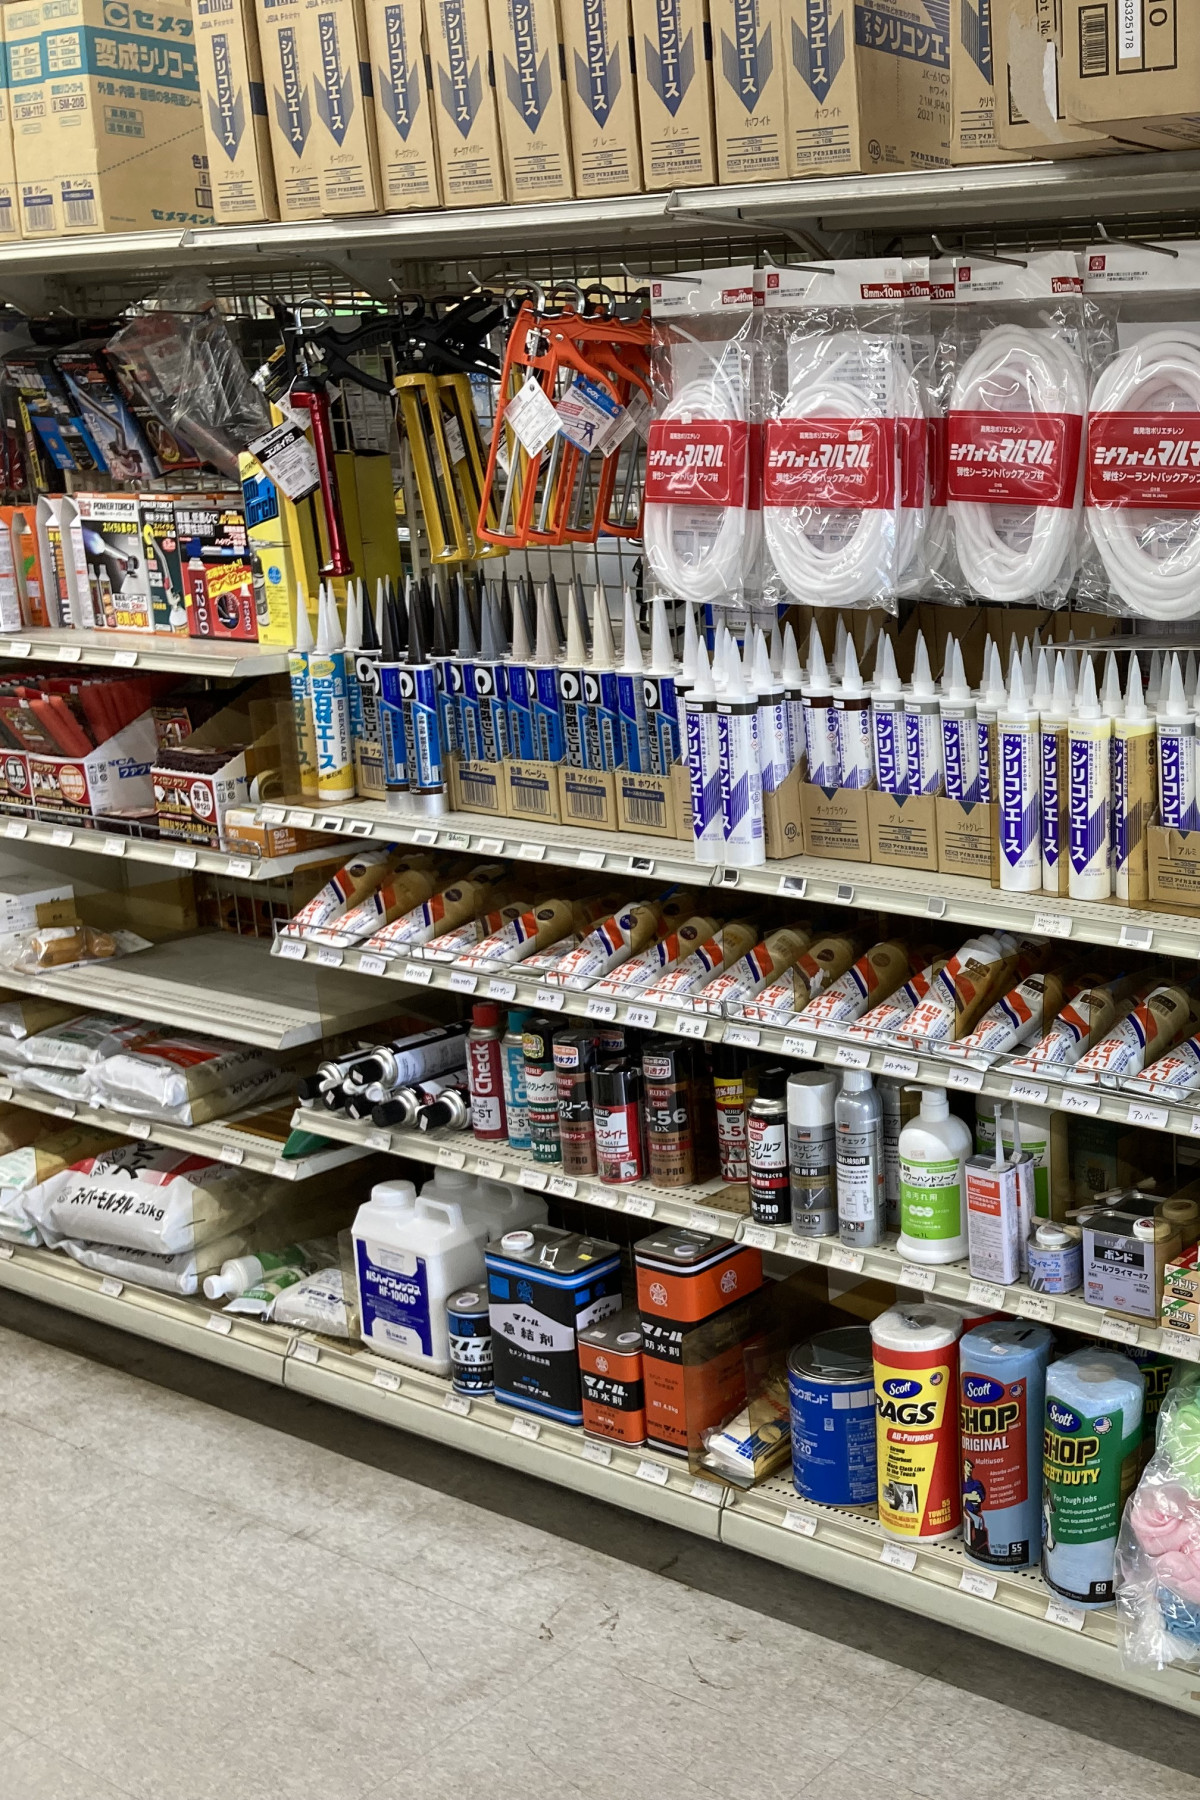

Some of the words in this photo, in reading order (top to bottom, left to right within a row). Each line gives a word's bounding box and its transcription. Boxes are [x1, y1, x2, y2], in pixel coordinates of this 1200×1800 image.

[863, 11, 873, 45] アイカ
[94, 37, 199, 80] 変成シリコー
[447, 13, 470, 122] シリコンエース
[514, 4, 539, 116] シリコンエース
[321, 25, 344, 130] シリコンエース
[387, 18, 409, 125] シリコンエース
[214, 46, 236, 146] シリコンエース
[281, 40, 303, 142] シリコンエース
[769, 444, 871, 469] ミナフォームマルマル
[949, 439, 1056, 465] ミナフォームマルマル
[194, 579, 210, 634] R200
[1071, 741, 1088, 749] アイカ
[1161, 739, 1178, 747] アイカ
[687, 725, 704, 827] シリコンエース
[1004, 745, 1021, 854] シリコンエース
[1043, 745, 1058, 853] シリコンエース
[1071, 751, 1088, 862] シリコンエース
[475, 1043, 493, 1094] Check
[794, 1167, 818, 1176] 切削剤
[902, 1172, 957, 1184] パワーハンドソープ
[71, 1186, 134, 1215] スーパーモルタル
[1104, 1249, 1133, 1264] ボンド
[378, 1284, 410, 1305] HF-1000
[1166, 1276, 1199, 1292] ウッドパテ
[513, 1313, 541, 1327] マノール
[1164, 1307, 1196, 1323] ウッドパテ
[503, 1322, 554, 1348] 急結剤
[645, 1340, 680, 1358] 防水剤
[583, 1374, 629, 1397] マノール
[889, 1382, 911, 1397] Scott
[967, 1381, 991, 1398] Scott
[588, 1388, 623, 1407] 防水剤
[876, 1392, 937, 1426] RAGS
[961, 1402, 1019, 1434] SHOP
[1050, 1404, 1074, 1426] Scott
[891, 1431, 934, 1443] All-Purpose
[962, 1436, 1010, 1452] ORIGINAL
[1043, 1430, 1099, 1467] SHOP
[975, 1456, 1004, 1465] Multiusos
[1063, 1467, 1101, 1486] DUTY
[1062, 1495, 1081, 1504] Tough
[1082, 1494, 1098, 1504] Jobs
[928, 1507, 951, 1519] TOWELS
[1011, 1543, 1023, 1553] 55
[1095, 1583, 1108, 1592] 60
